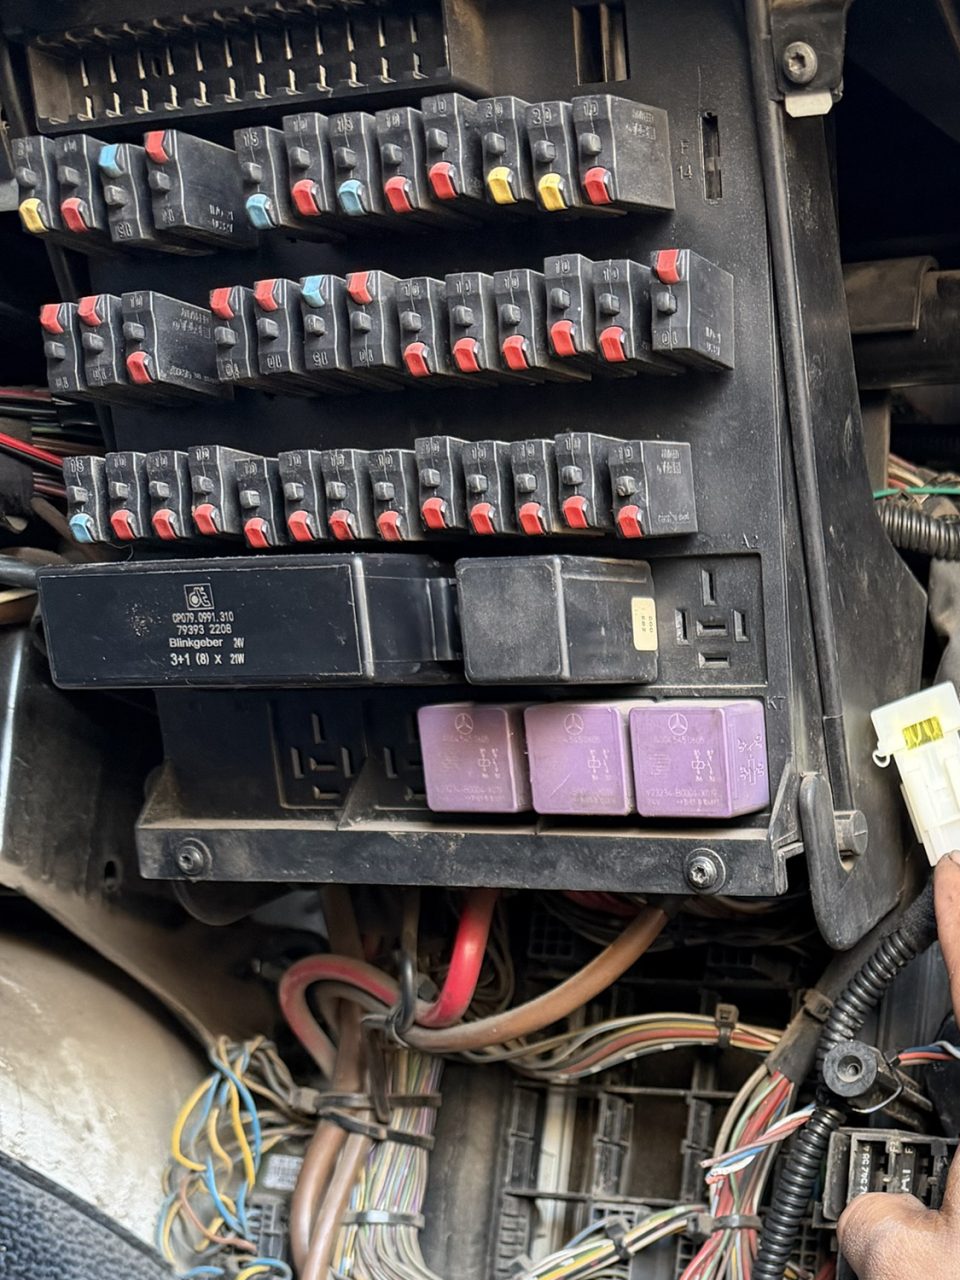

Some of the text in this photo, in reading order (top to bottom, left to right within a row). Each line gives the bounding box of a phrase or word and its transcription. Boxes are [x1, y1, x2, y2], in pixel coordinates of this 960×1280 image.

[678, 165, 692, 180] 14
[555, 259, 571, 273] 10
[603, 267, 620, 281] 10
[176, 623, 232, 635] 79393 2208
[168, 637, 246, 649] Blinkgeber 24V
[170, 652, 191, 666] 3+1
[195, 652, 210, 665] (8)
[229, 653, 245, 665] 21W
